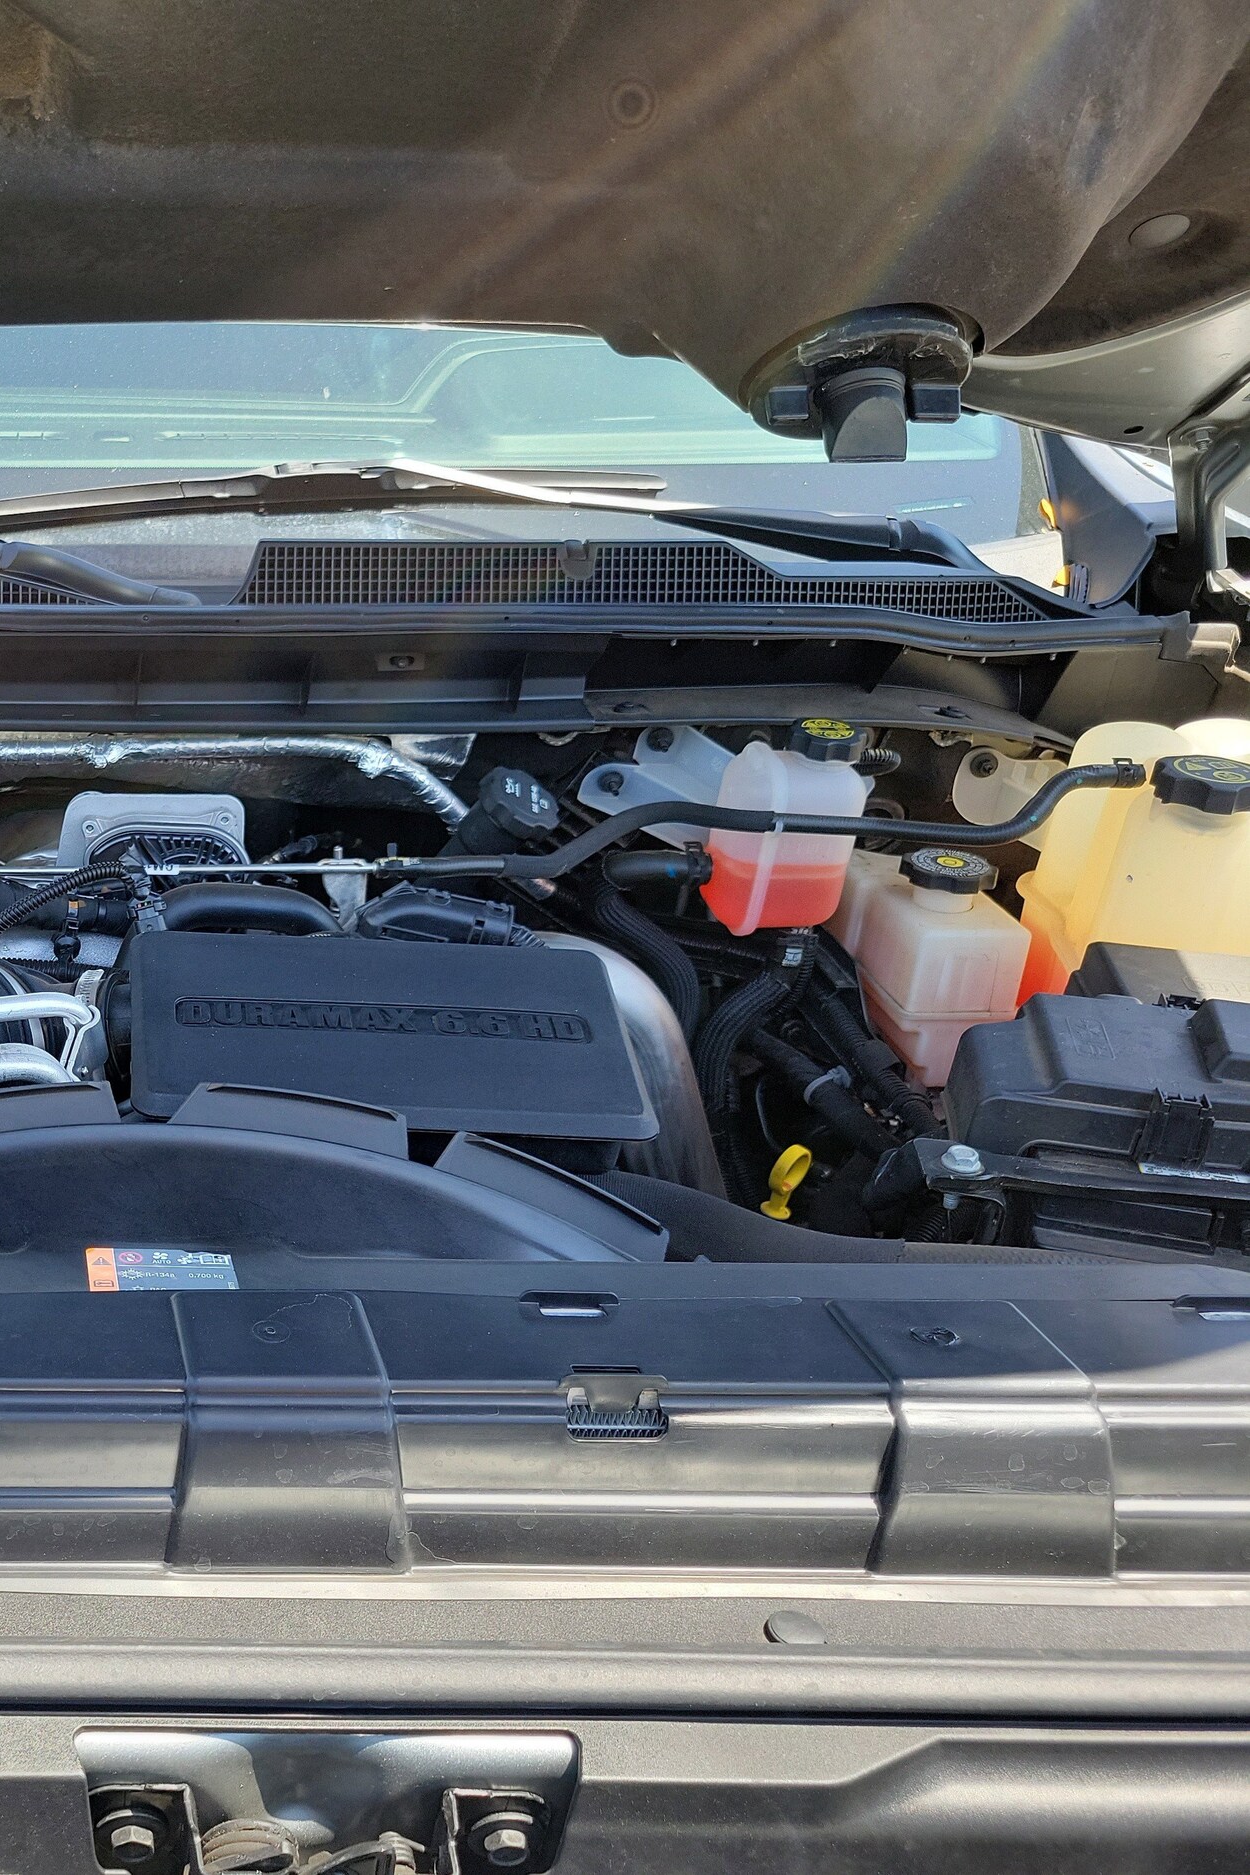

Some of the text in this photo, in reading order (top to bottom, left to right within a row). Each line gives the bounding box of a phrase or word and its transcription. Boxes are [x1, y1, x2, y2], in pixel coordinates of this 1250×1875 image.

[181, 1000, 587, 1042] DURAMAX 6.6 HD
